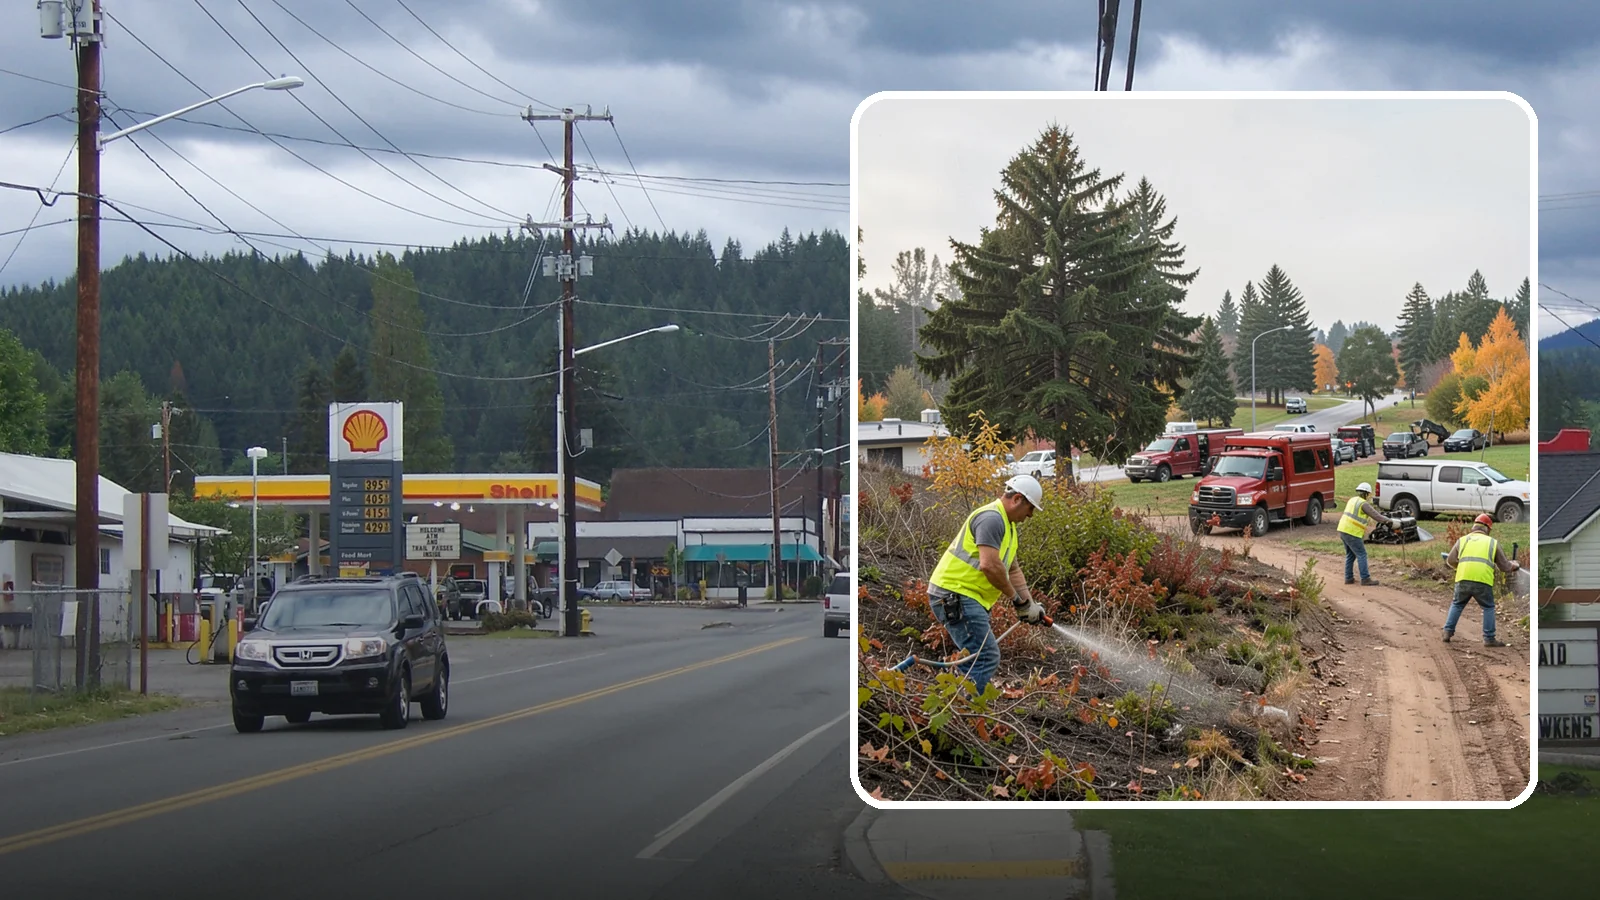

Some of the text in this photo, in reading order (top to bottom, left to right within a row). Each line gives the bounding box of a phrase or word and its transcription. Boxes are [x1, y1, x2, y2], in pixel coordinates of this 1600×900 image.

[366, 479, 383, 490] 395
[490, 484, 547, 499] Shell
[366, 494, 383, 504] 405
[366, 508, 383, 518] 415
[366, 522, 383, 533] 429
[1538, 643, 1567, 665] AID
